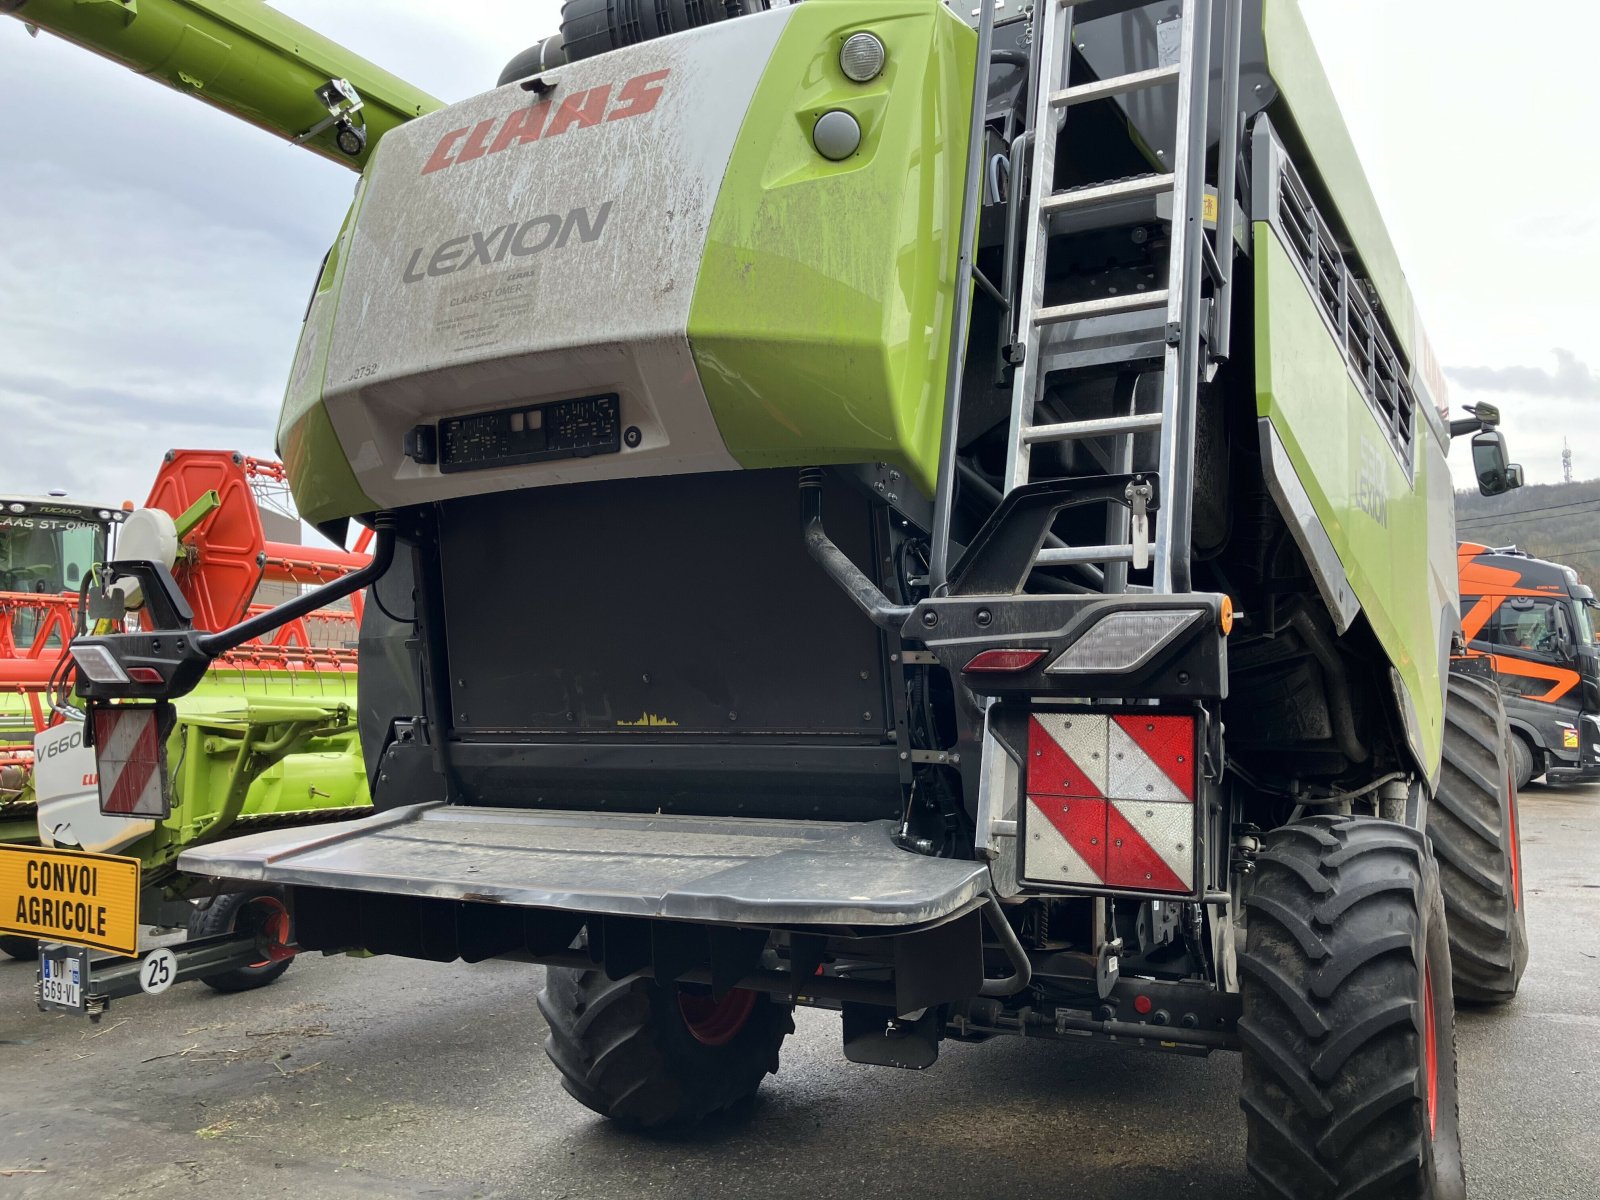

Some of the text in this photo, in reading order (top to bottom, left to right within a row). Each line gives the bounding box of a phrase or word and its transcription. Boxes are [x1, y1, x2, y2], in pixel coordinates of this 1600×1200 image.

[421, 68, 671, 176] CLAAS
[402, 200, 613, 284] LEXION
[450, 293, 479, 307] CLAAS
[482, 289, 493, 300] ST
[496, 283, 522, 297] OMER
[40, 506, 82, 515] TUCANO
[27, 860, 97, 896] CONVOI
[16, 895, 106, 936] AGRICOLE
[148, 957, 169, 987] 25
[44, 980, 77, 1004] 569-VL
